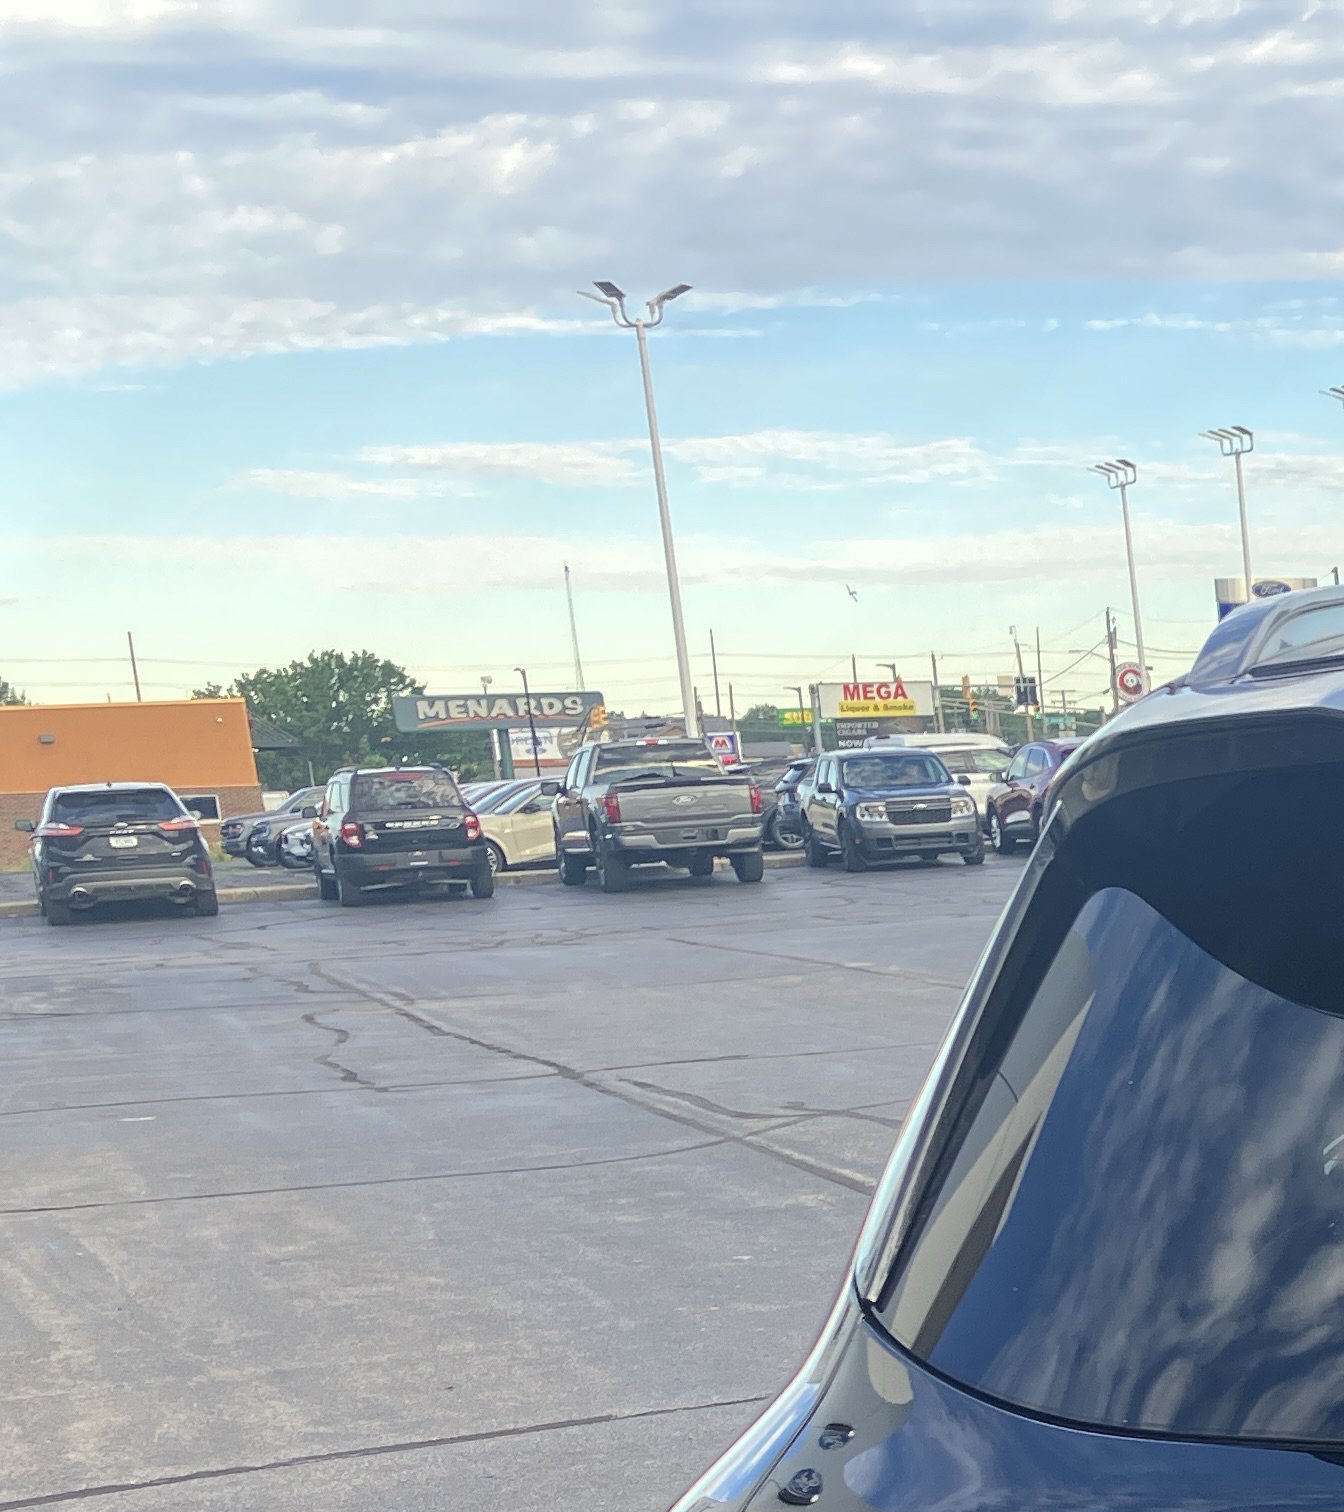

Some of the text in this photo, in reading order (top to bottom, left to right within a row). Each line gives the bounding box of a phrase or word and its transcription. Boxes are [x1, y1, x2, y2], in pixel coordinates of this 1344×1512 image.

[842, 681, 908, 701] MEGA
[416, 697, 584, 720] MENARDS
[840, 704, 870, 713] Liquor
